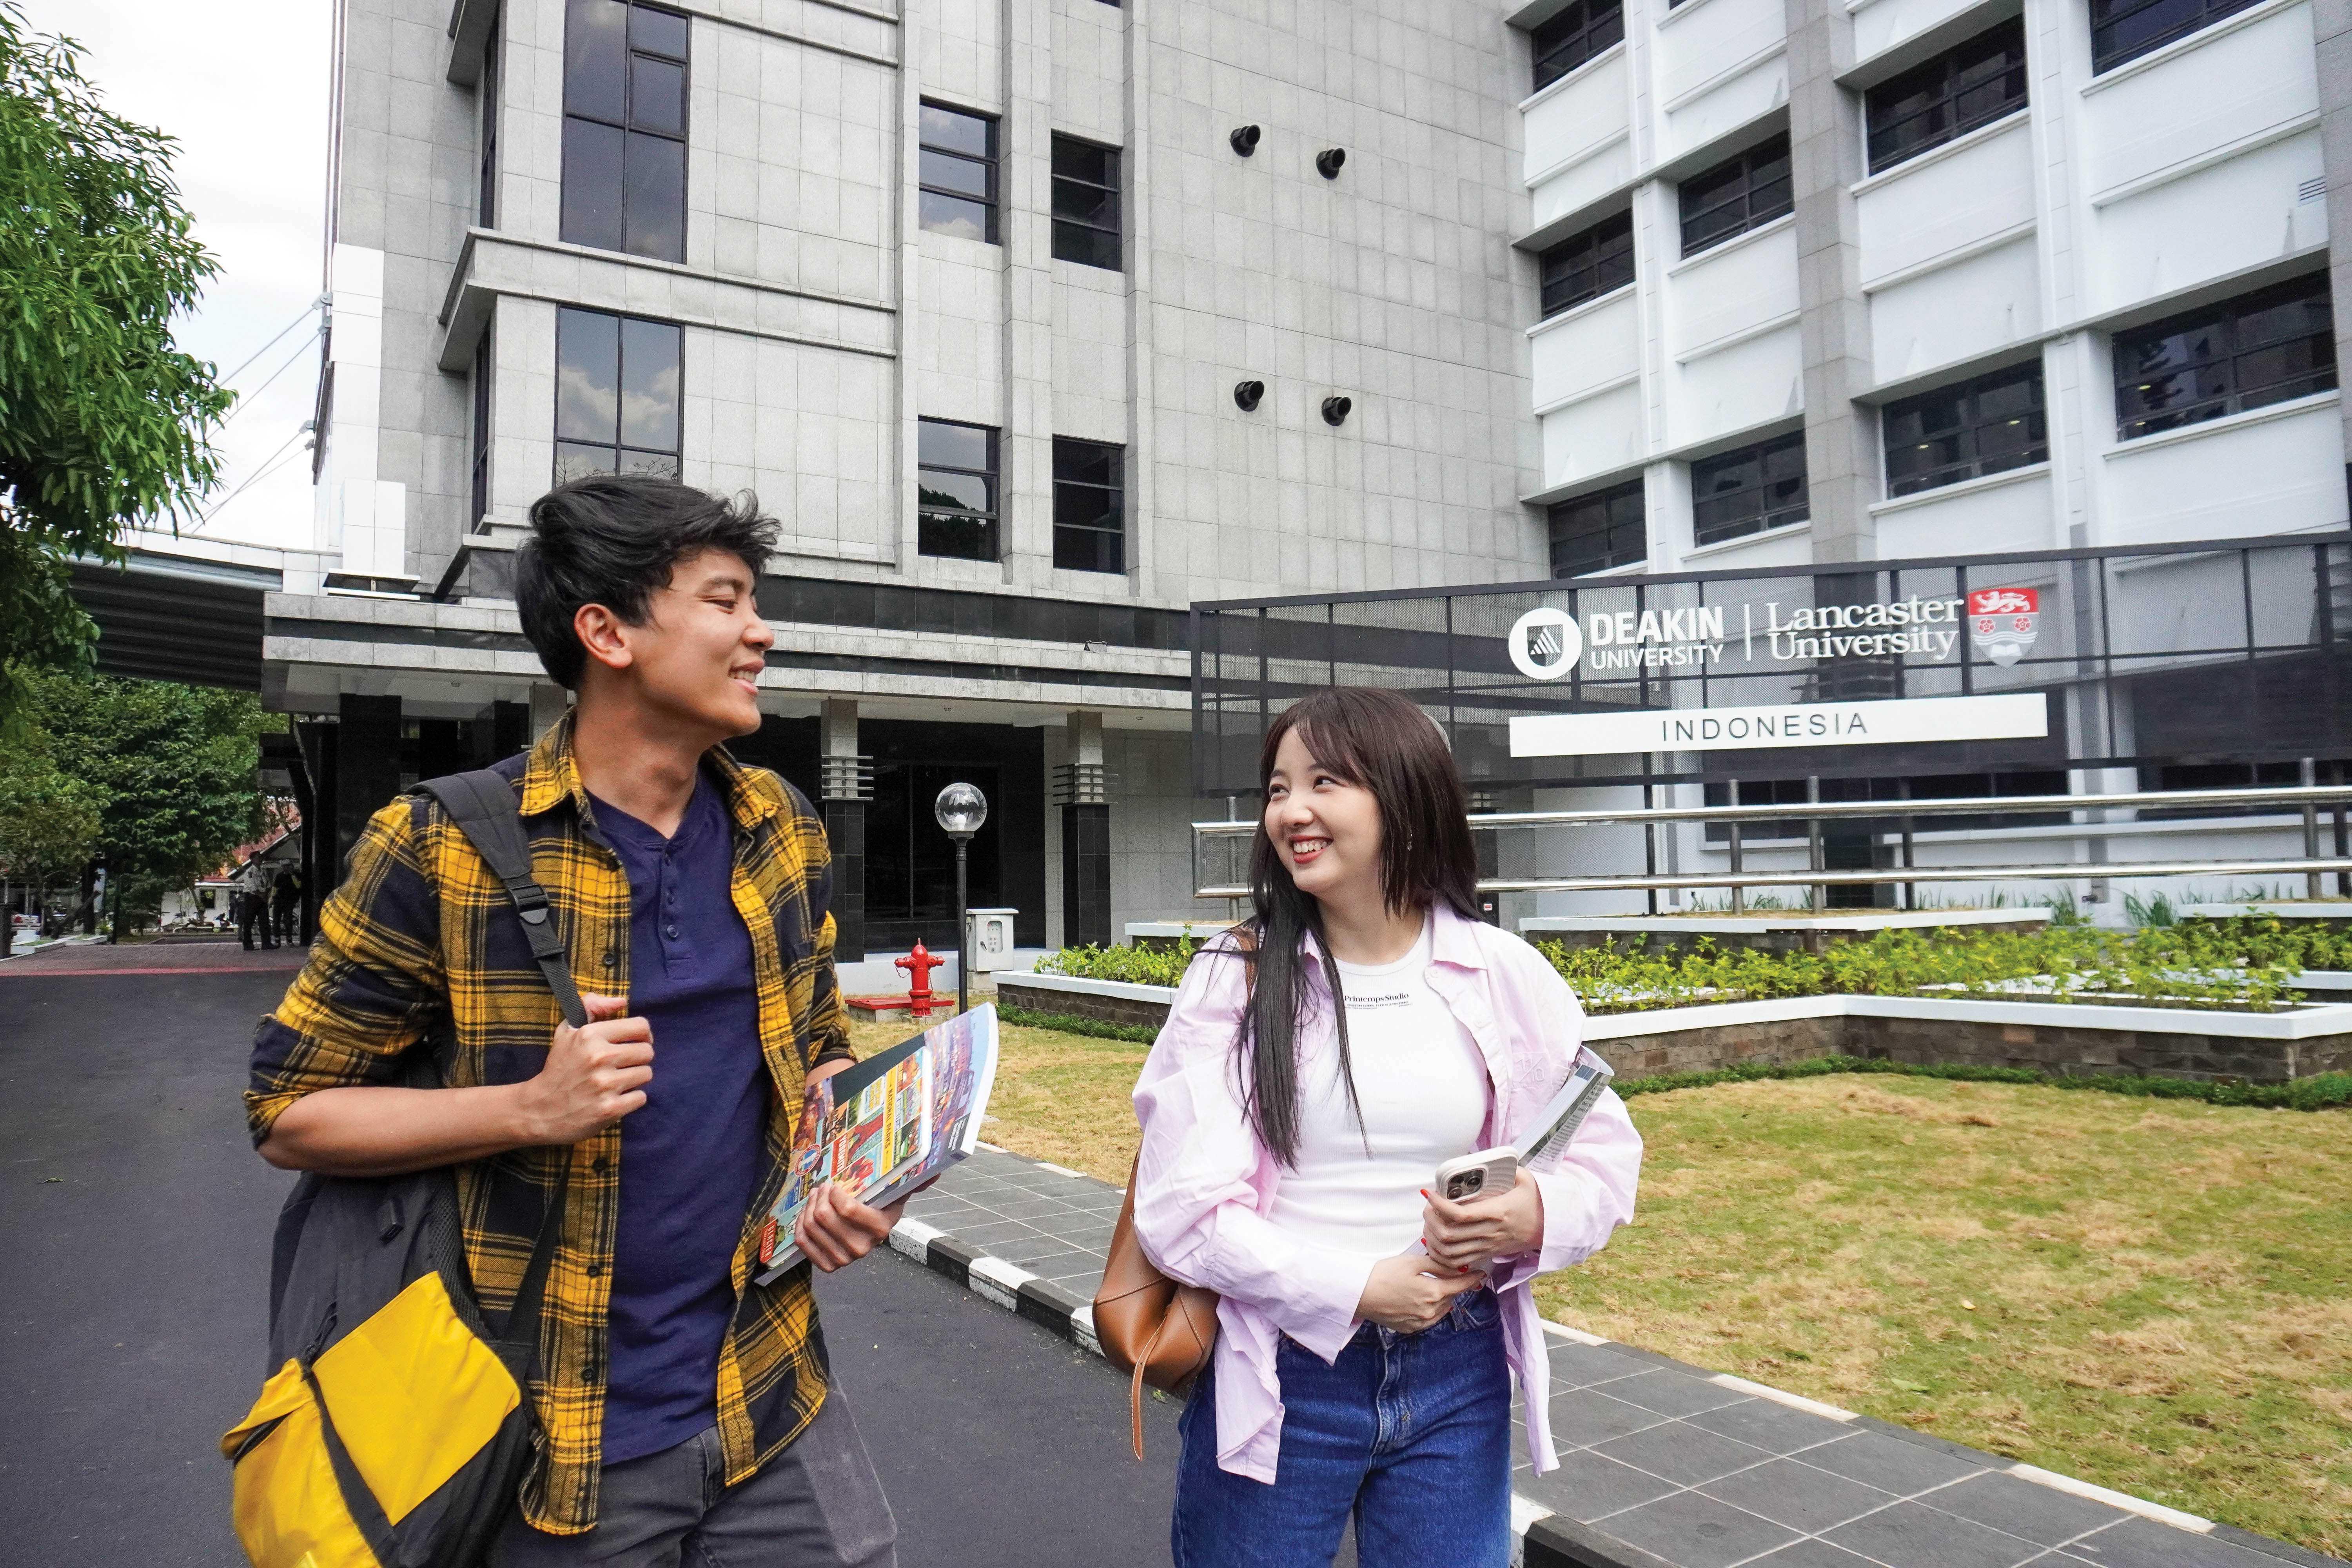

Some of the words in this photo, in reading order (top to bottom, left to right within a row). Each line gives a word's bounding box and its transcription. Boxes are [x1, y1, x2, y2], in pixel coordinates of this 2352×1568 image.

[1590, 606, 1724, 646] DEAKIN
[1766, 594, 1964, 632] Lancaster
[1591, 644, 1724, 670] UNIVERSITY
[1767, 626, 1958, 661] University
[1662, 712, 1868, 741] INDONESIA
[1345, 995, 1384, 1003] Printemps
[1385, 993, 1409, 1002] Studio
[837, 1134, 847, 1173] YOSEMITE
[765, 1225, 775, 1257] GLACIER
